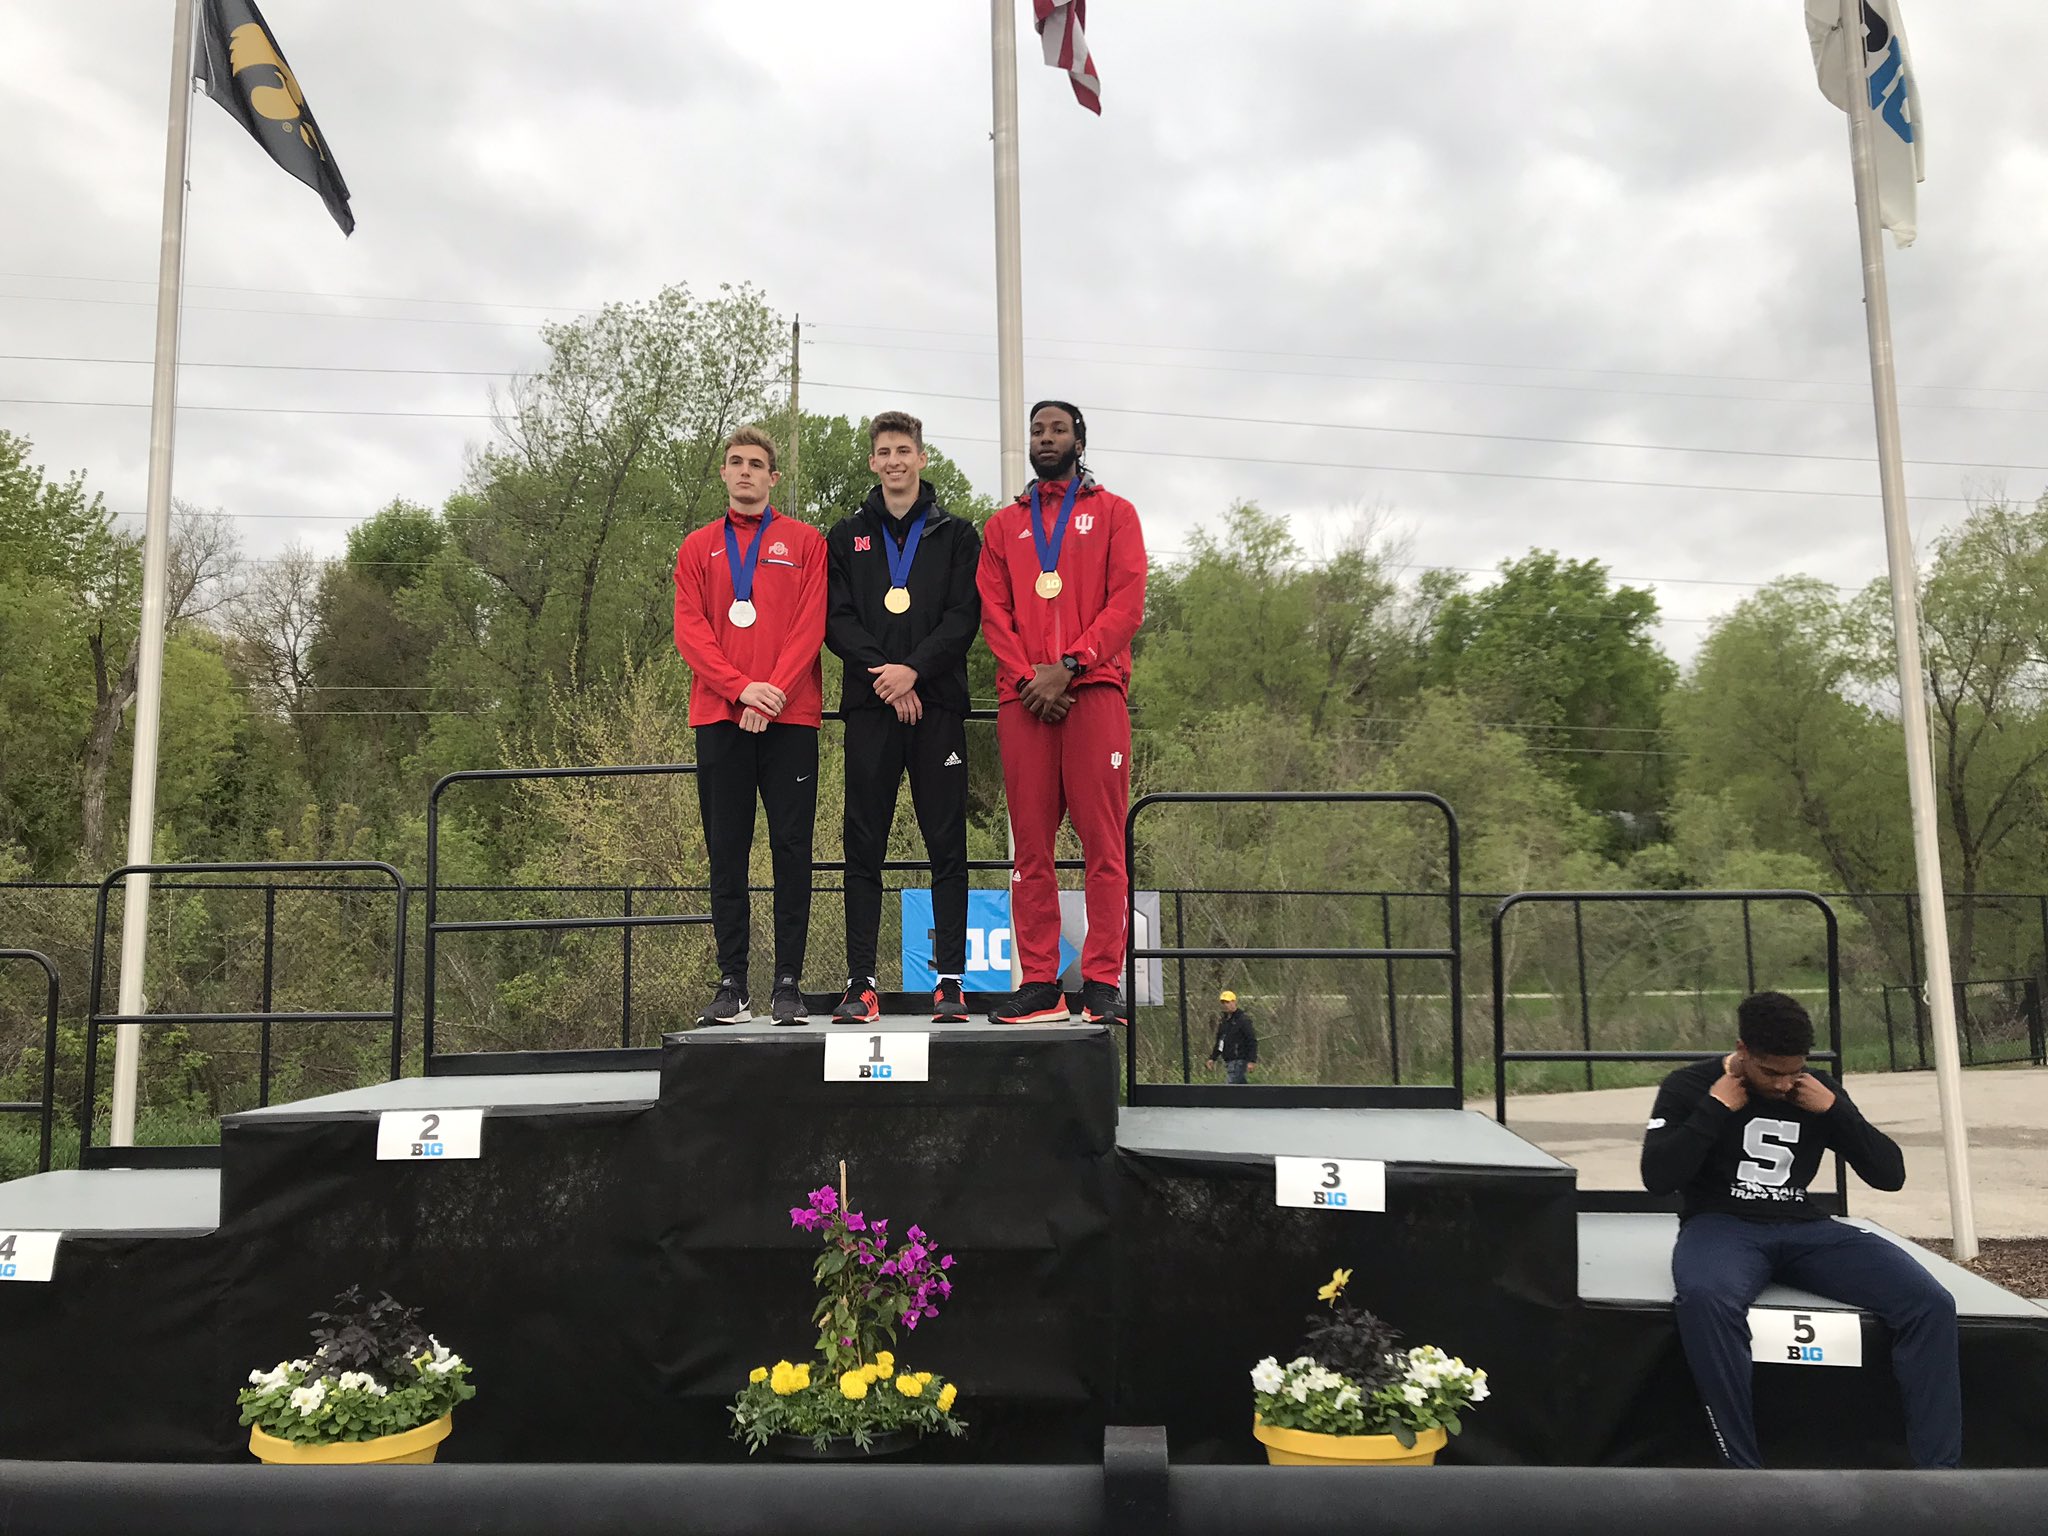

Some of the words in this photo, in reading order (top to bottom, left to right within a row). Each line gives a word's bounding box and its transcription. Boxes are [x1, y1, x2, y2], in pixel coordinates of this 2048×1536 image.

[854, 536, 871, 552] N
[868, 1035, 885, 1062] 1
[419, 1113, 440, 1140] 2
[1737, 1117, 1800, 1187] S
[1321, 1162, 1342, 1189] 3
[0, 1234, 17, 1261] 4
[1793, 1314, 1816, 1344] 5
